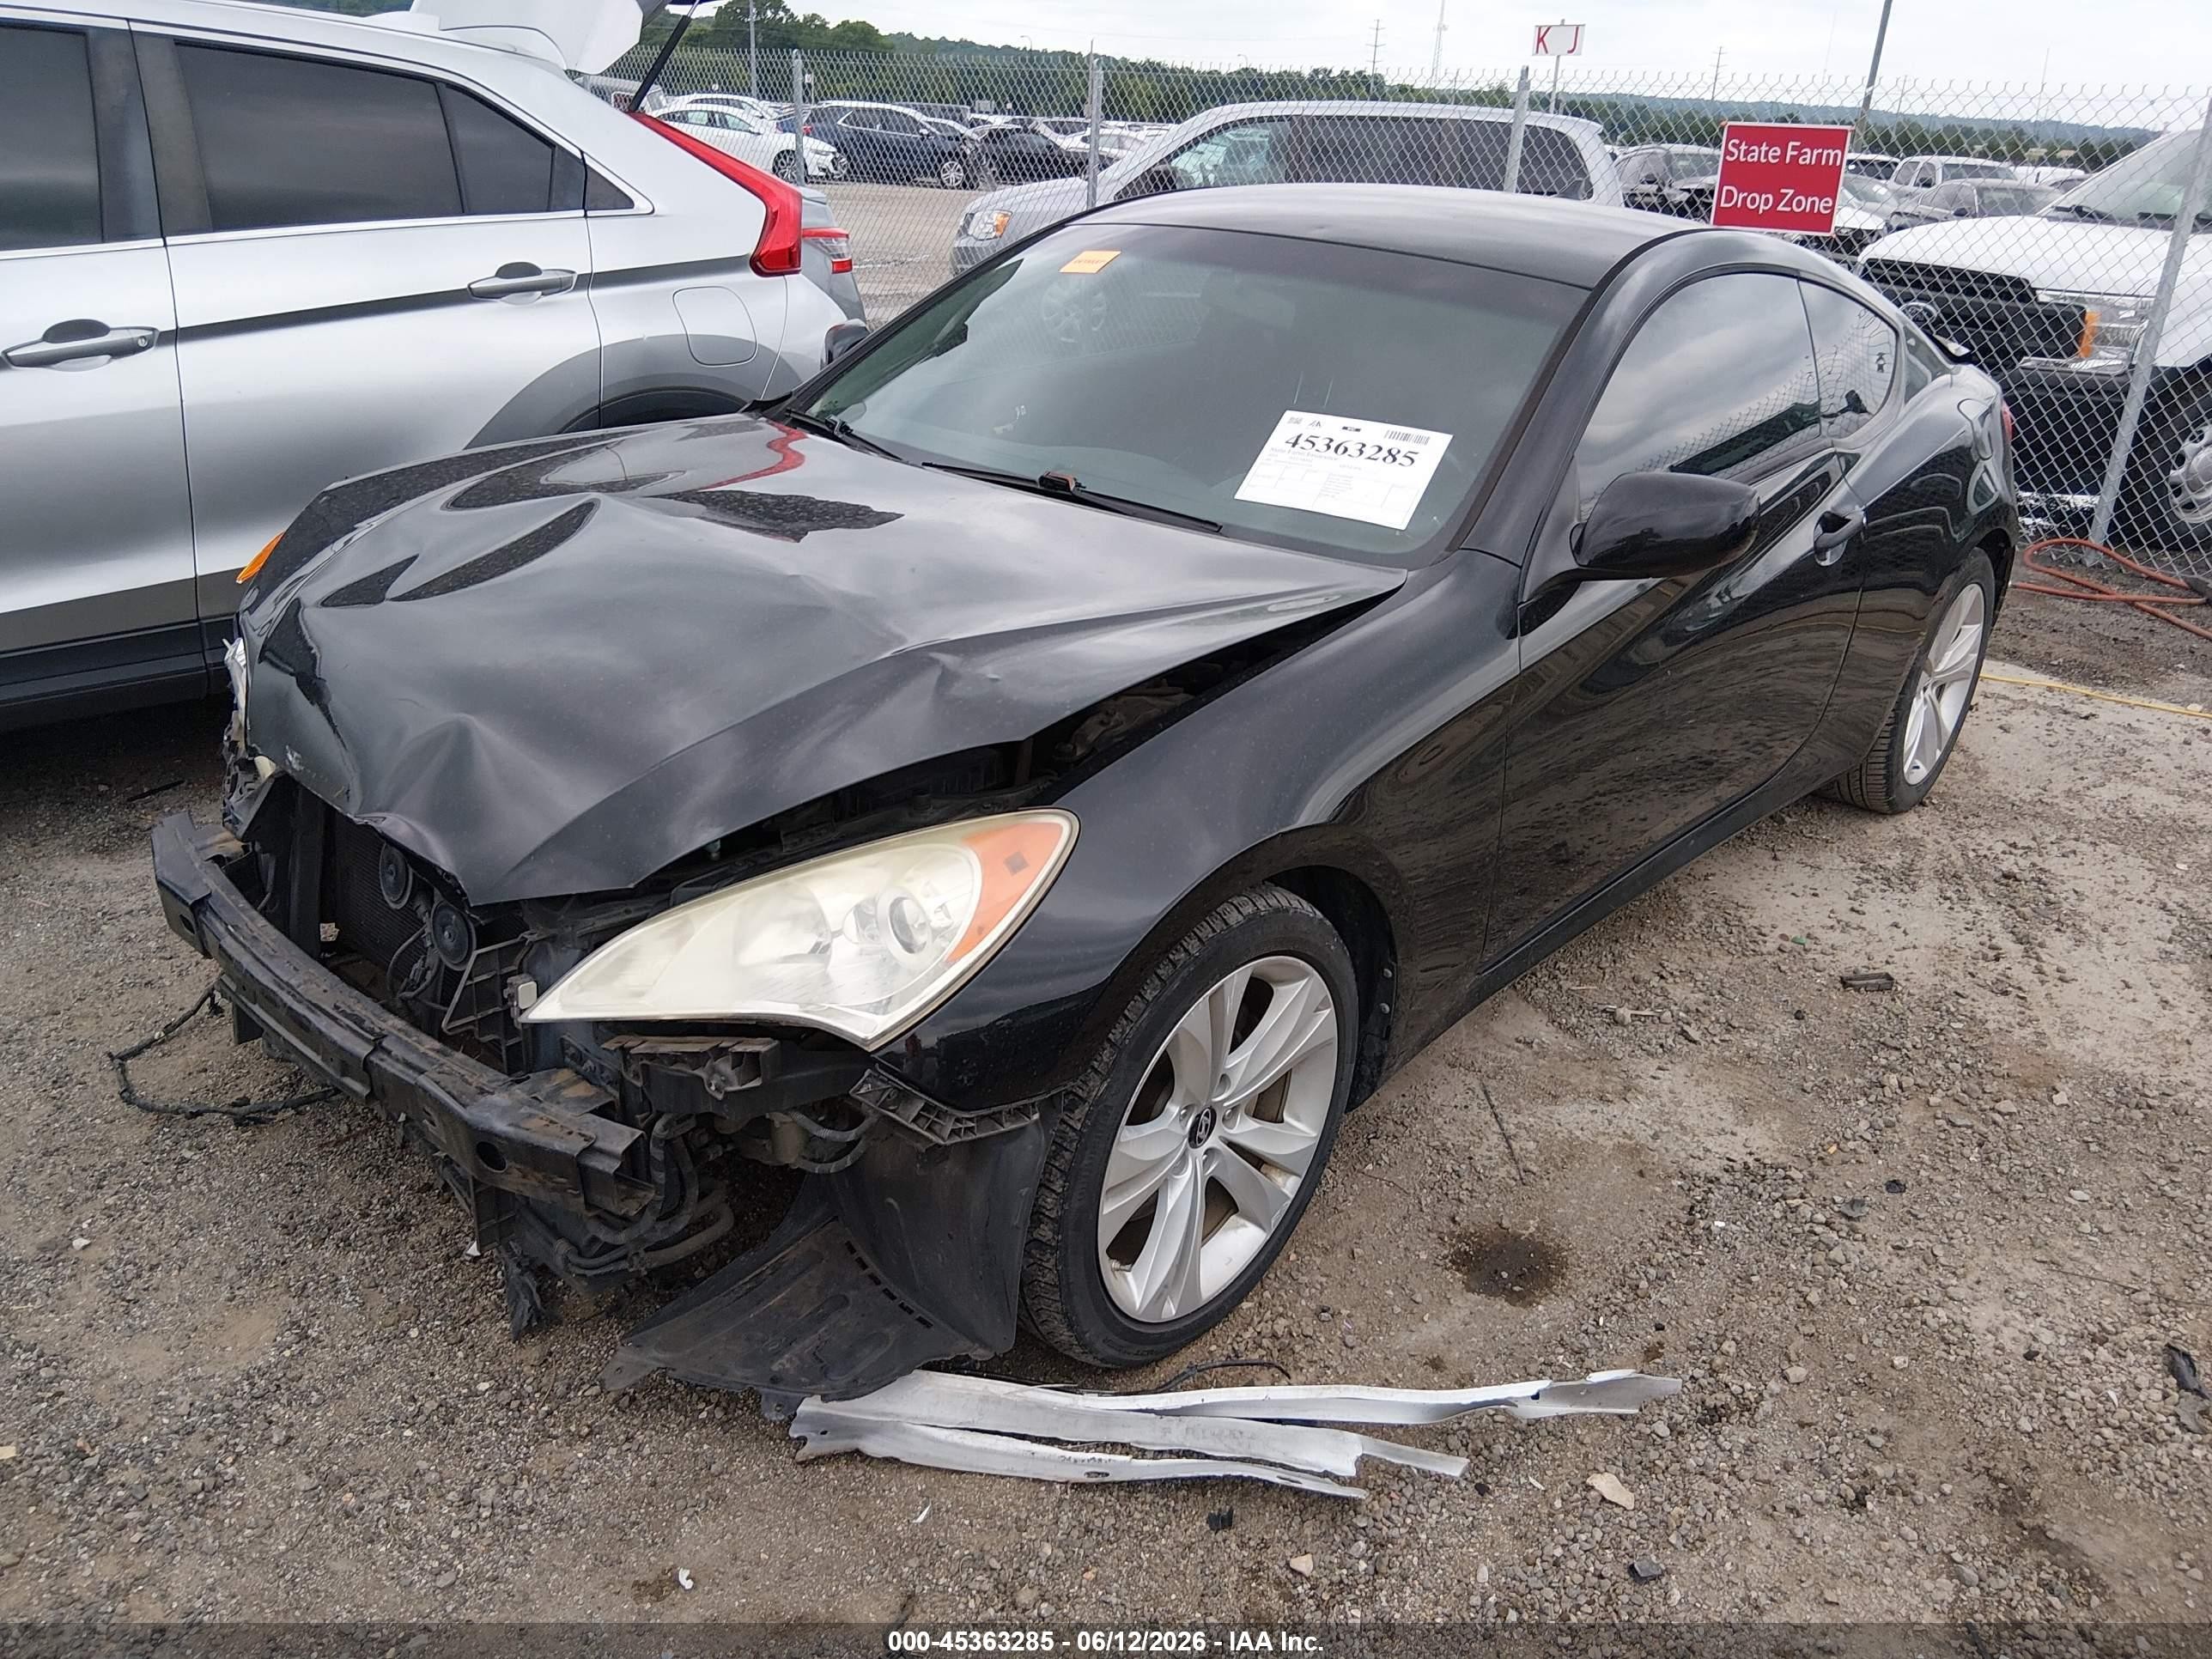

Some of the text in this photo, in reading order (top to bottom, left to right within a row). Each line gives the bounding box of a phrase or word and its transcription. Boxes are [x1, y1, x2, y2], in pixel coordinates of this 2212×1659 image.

[1535, 25, 1579, 54] K J
[1725, 138, 1843, 167] State Farm
[1720, 185, 1833, 215] Drop Zone
[1285, 432, 1420, 468] 45363285
